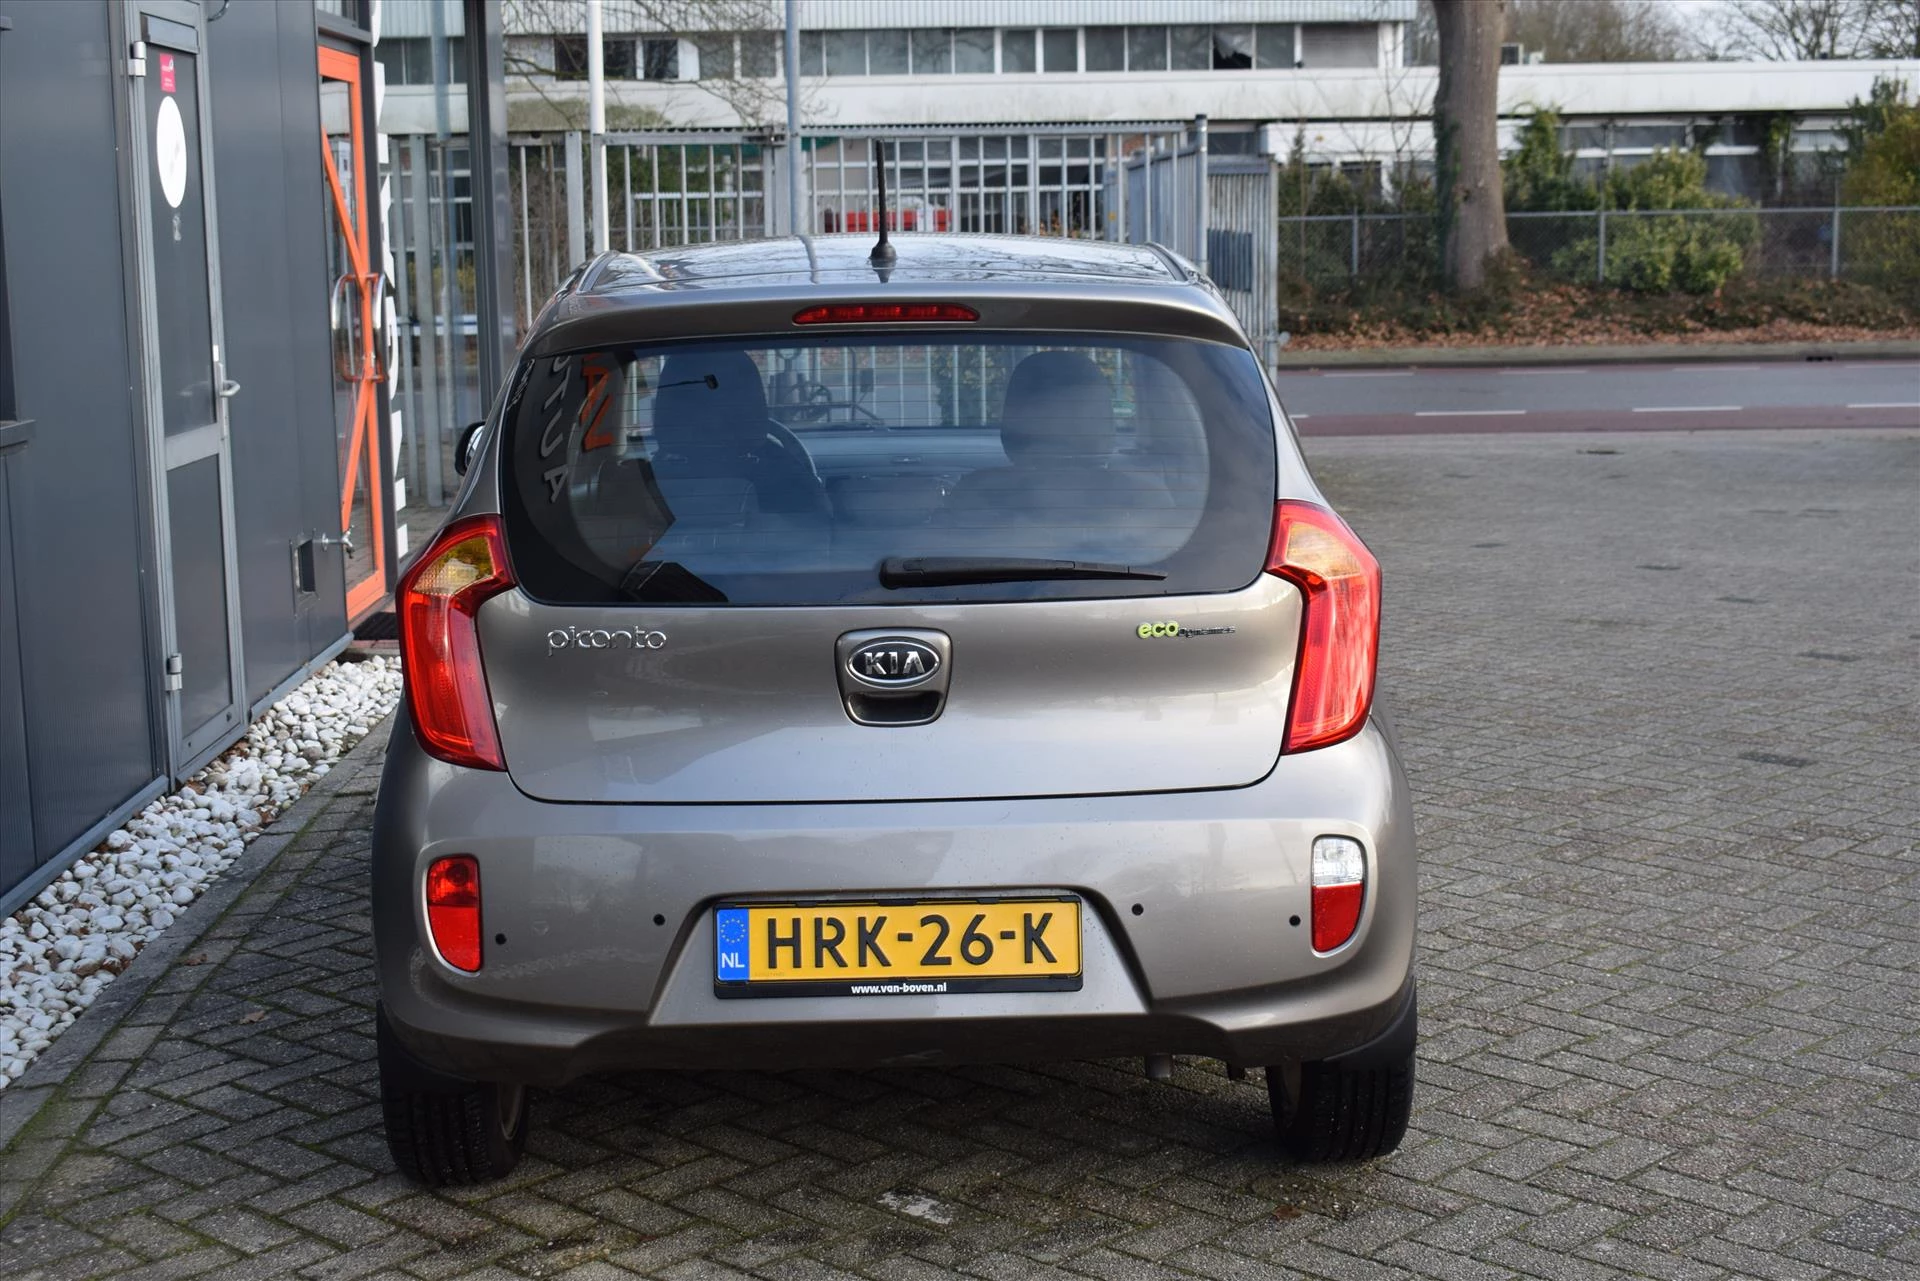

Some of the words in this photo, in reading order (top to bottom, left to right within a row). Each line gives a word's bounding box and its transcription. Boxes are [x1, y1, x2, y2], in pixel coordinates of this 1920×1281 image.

[547, 625, 667, 656] picanto
[864, 651, 925, 675] KIA
[767, 912, 1058, 969] HRK-26-K
[721, 952, 745, 969] NL
[851, 982, 947, 994] www.van-boven.nl
